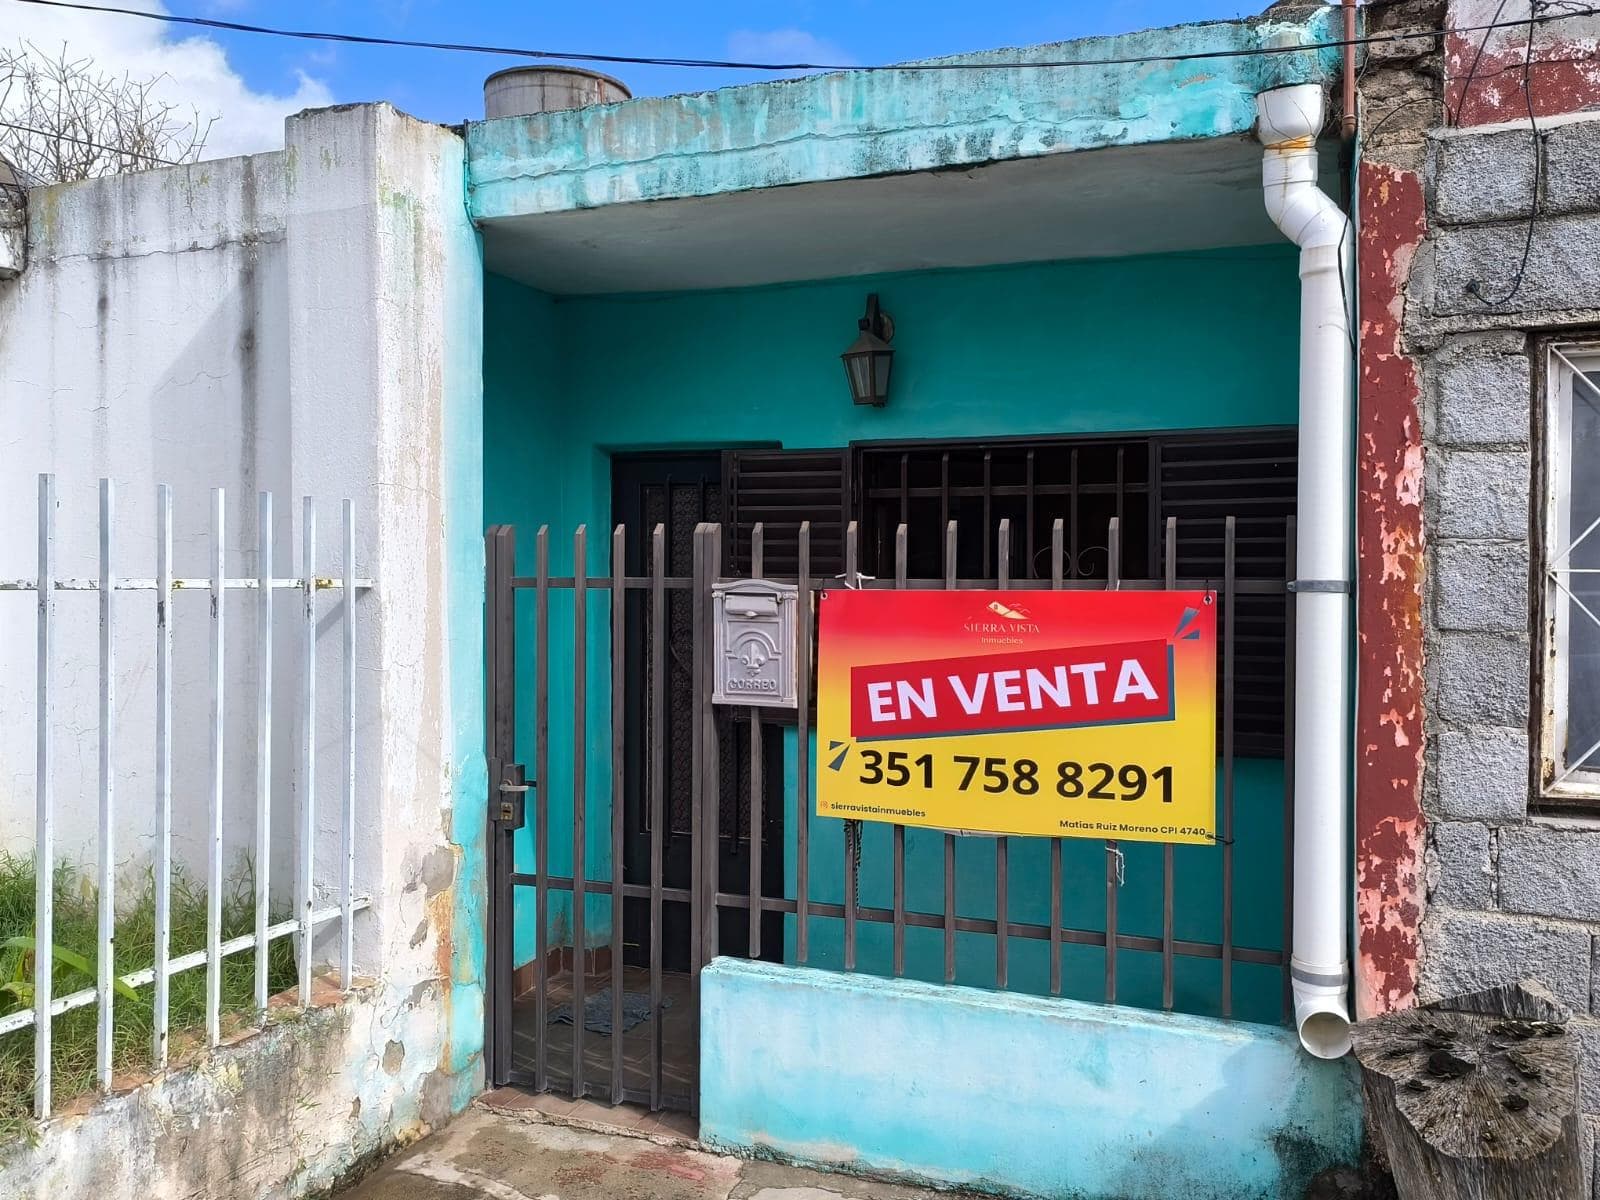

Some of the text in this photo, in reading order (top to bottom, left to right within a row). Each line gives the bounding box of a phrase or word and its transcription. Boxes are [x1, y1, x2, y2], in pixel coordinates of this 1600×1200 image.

[963, 623, 1040, 633] SIERRA VISTA
[981, 636, 1023, 645] Inmuebles
[727, 679, 777, 690] CORREO
[867, 659, 1158, 722] EN VENTA
[860, 749, 1173, 803] 351 758 8291
[830, 801, 926, 817] sierravistainmuebles
[1096, 822, 1117, 832] Ruiz
[1119, 824, 1158, 834] Moreno
[1160, 827, 1177, 835] CPI
[1180, 828, 1206, 837] 4740
